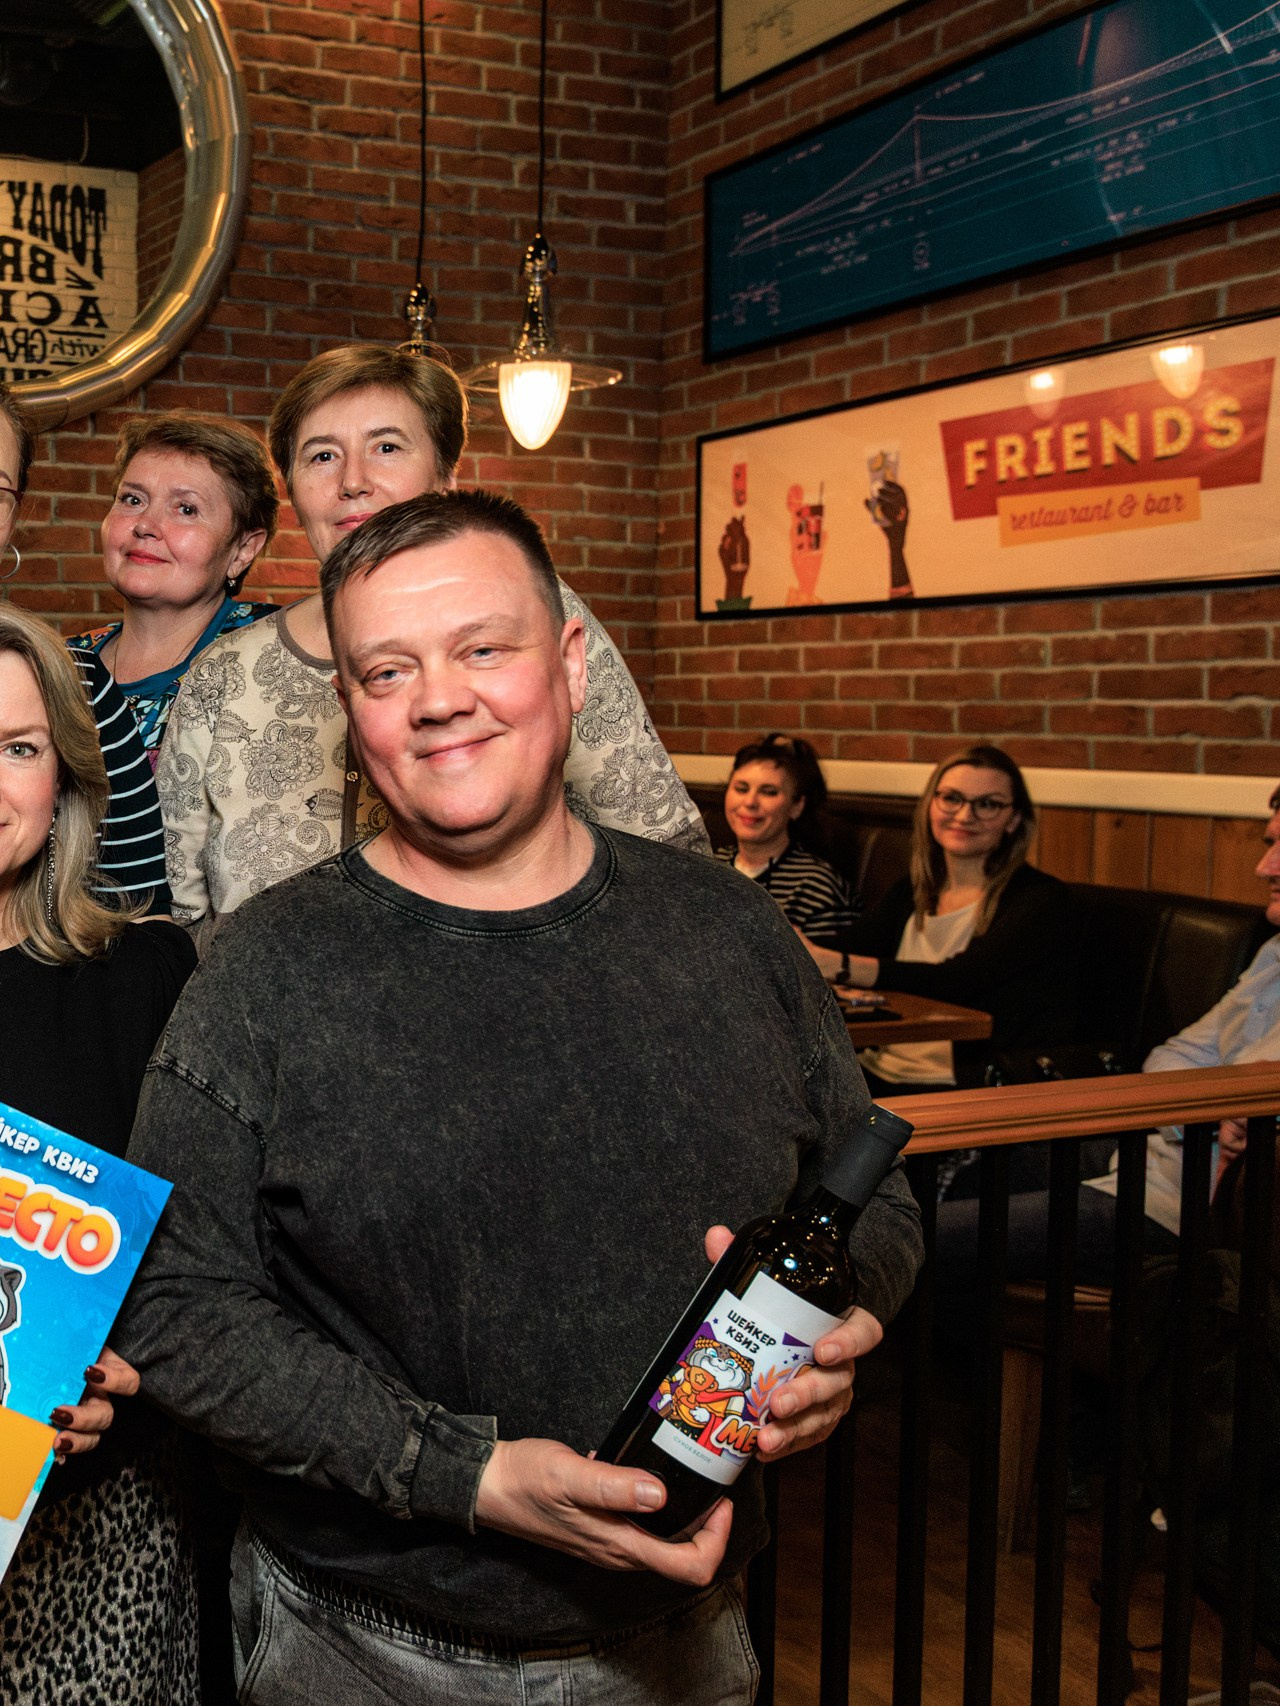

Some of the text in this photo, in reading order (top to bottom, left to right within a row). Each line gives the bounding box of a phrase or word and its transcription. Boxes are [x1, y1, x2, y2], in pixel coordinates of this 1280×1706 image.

[963, 395, 1245, 489] FRIENDS
[1009, 492, 1185, 531] restaurant & bar
[42, 1145, 99, 1184] КВИЗ
[725, 1325, 761, 1354] КВИЗ
[727, 1309, 777, 1348] ШЕЙКЕР
